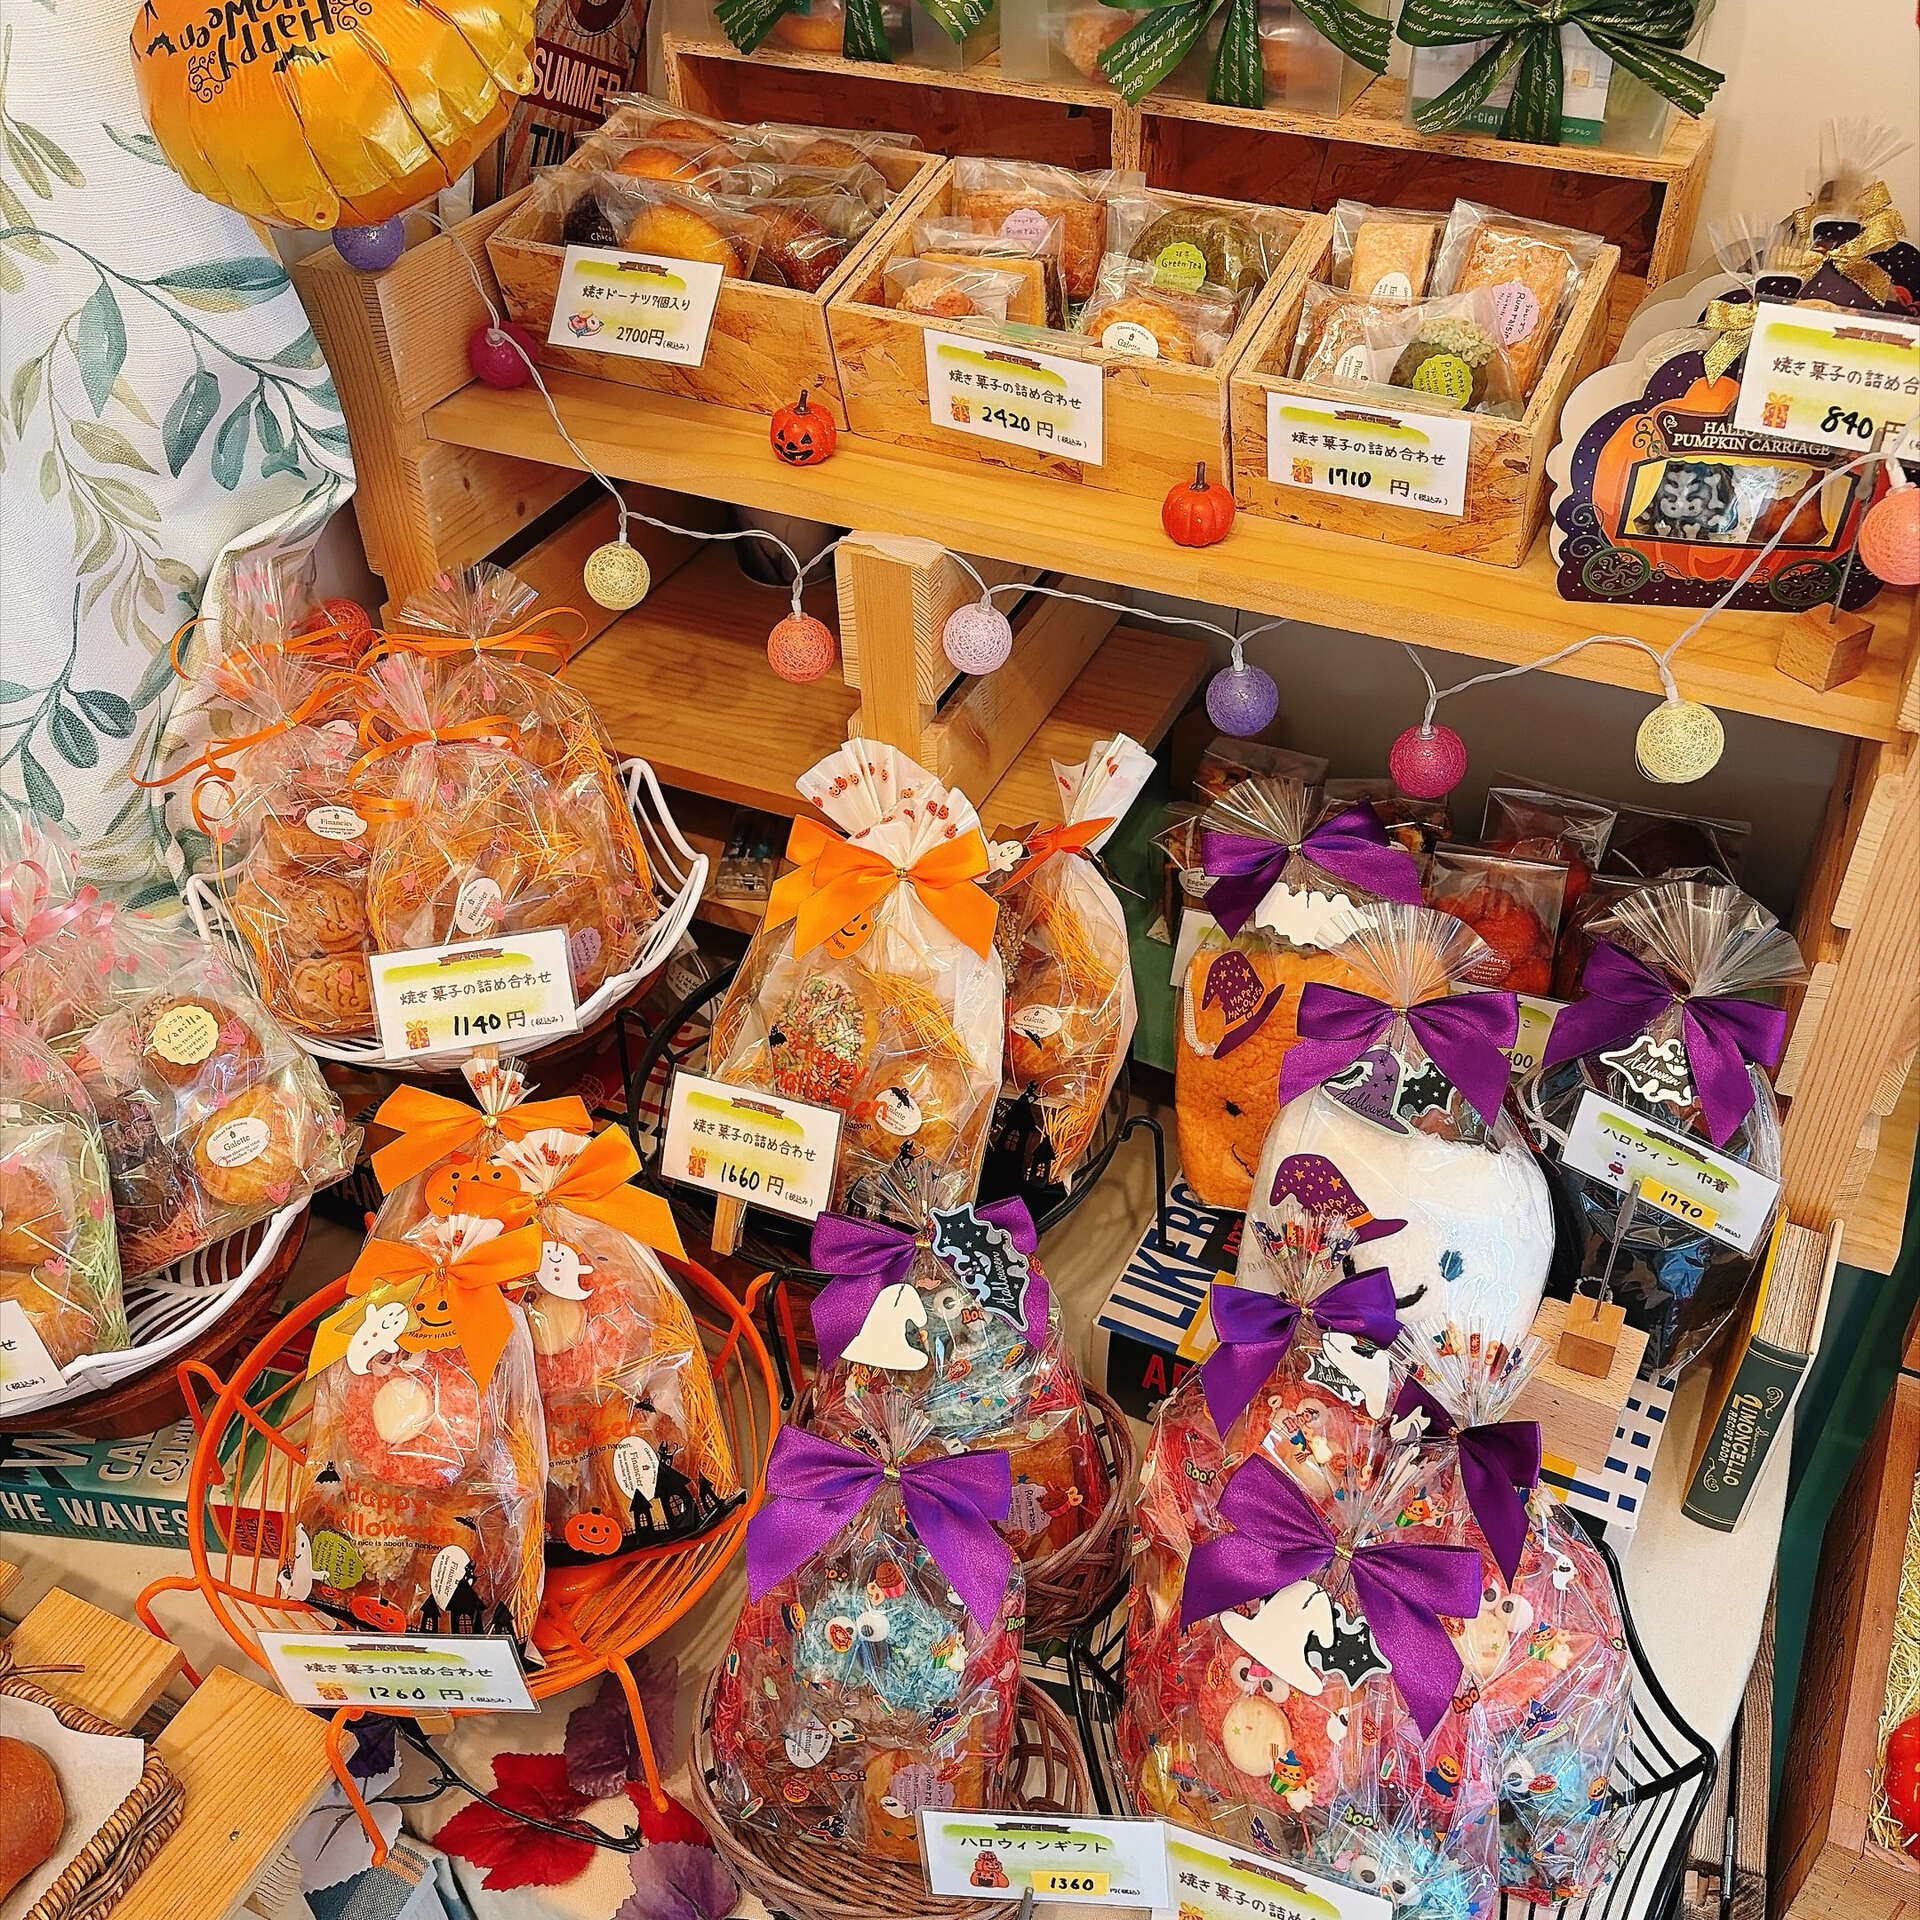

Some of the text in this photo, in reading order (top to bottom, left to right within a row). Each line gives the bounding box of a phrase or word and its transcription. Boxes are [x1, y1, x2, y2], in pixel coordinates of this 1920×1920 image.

[1161, 258, 1202, 270] Green Tea
[582, 284, 690, 311] 焼きドーナツ7個入り
[949, 369, 1082, 410] 焼き菓子の詰め合わせ
[982, 406, 1030, 431] 2420
[1036, 421, 1053, 438] 円
[1821, 405, 1873, 439] 840
[1291, 431, 1446, 467] 焼き菓子の詰め合わせ
[1672, 432, 1831, 456] PUMPKIN CARRIAGE
[1328, 467, 1372, 488] 1710
[1390, 479, 1410, 498] 円
[400, 971, 552, 1006] 焼き菓子の詰め合わせ
[1230, 982, 1256, 1007] HAPPY
[162, 1013, 202, 1044] Vanilla
[453, 1013, 501, 1036] 1140
[506, 1009, 525, 1029] 円
[1623, 1052, 1682, 1087] Halloween
[1336, 1088, 1396, 1120] Halloween
[223, 1134, 251, 1152] Galette
[693, 1118, 816, 1162] 焼き菓子の詰め合わせ
[1603, 1128, 1729, 1194] ハロウィン 巾着
[721, 1162, 760, 1190] 1660
[766, 1175, 784, 1196] 円
[1311, 1194, 1349, 1213] HAPPY
[1660, 1190, 1703, 1218] 1790
[990, 1251, 1017, 1309] Halloween
[1109, 1228, 1220, 1331] LIKE
[408, 1330, 432, 1340] HAPPY
[1718, 1409, 1738, 1464] RECIPE BOOK
[1723, 1394, 1763, 1486] LIMONCELLO
[630, 1451, 643, 1488] Financier
[344, 1474, 428, 1518] Happy
[0, 1491, 189, 1537] HE WAVES
[383, 1540, 405, 1549] about
[443, 1559, 459, 1597] Financier
[304, 1662, 494, 1678] 焼き菓子の詰め合わせ
[369, 1686, 425, 1700] 1260
[439, 1688, 464, 1701] 円
[961, 1837, 1108, 1854] ハロウィンギフト
[1050, 1877, 1094, 1891] 1360
[1178, 1872, 1318, 1920] 焼き菓子の詰め
